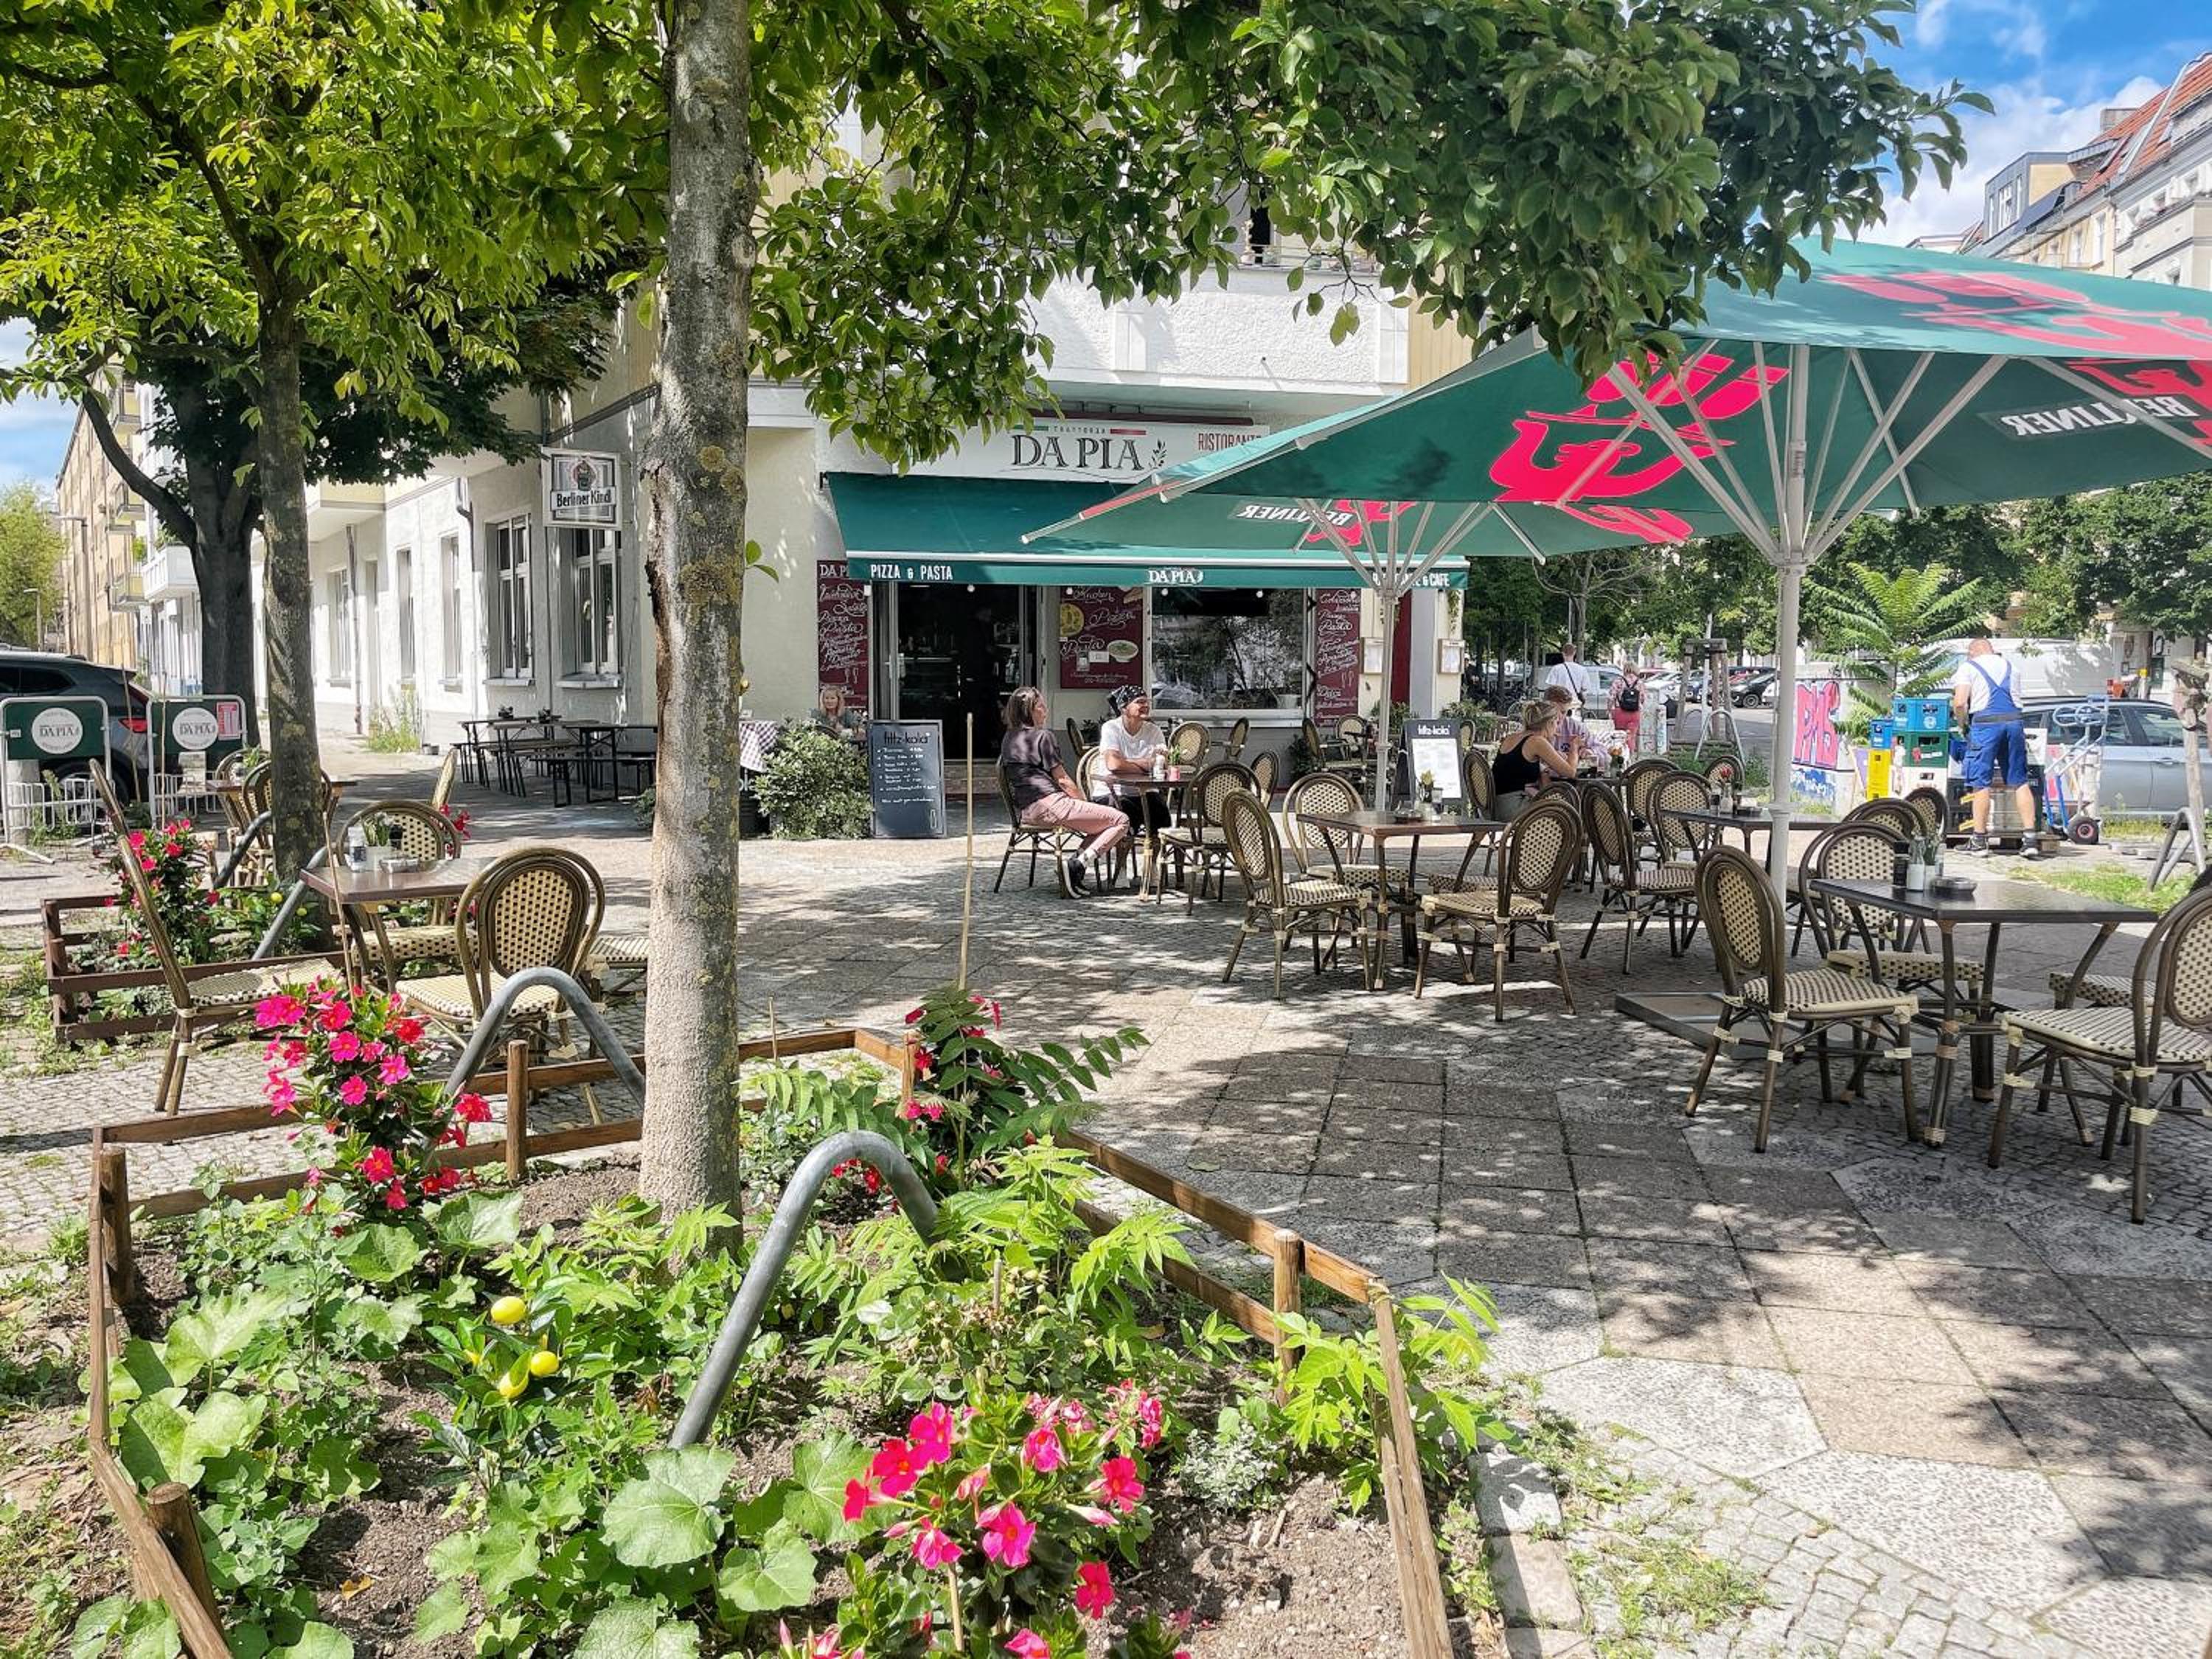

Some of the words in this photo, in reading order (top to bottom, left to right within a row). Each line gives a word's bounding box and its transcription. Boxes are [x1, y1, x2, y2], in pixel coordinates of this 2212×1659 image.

[1011, 434, 1069, 467] DA
[1077, 437, 1145, 471] PIA
[556, 492, 590, 507] Berliner
[820, 564, 838, 576] DA
[870, 564, 900, 579] PIZZA
[921, 565, 953, 580] PASTA
[1148, 570, 1169, 583] DA
[1171, 569, 1196, 584] PIA
